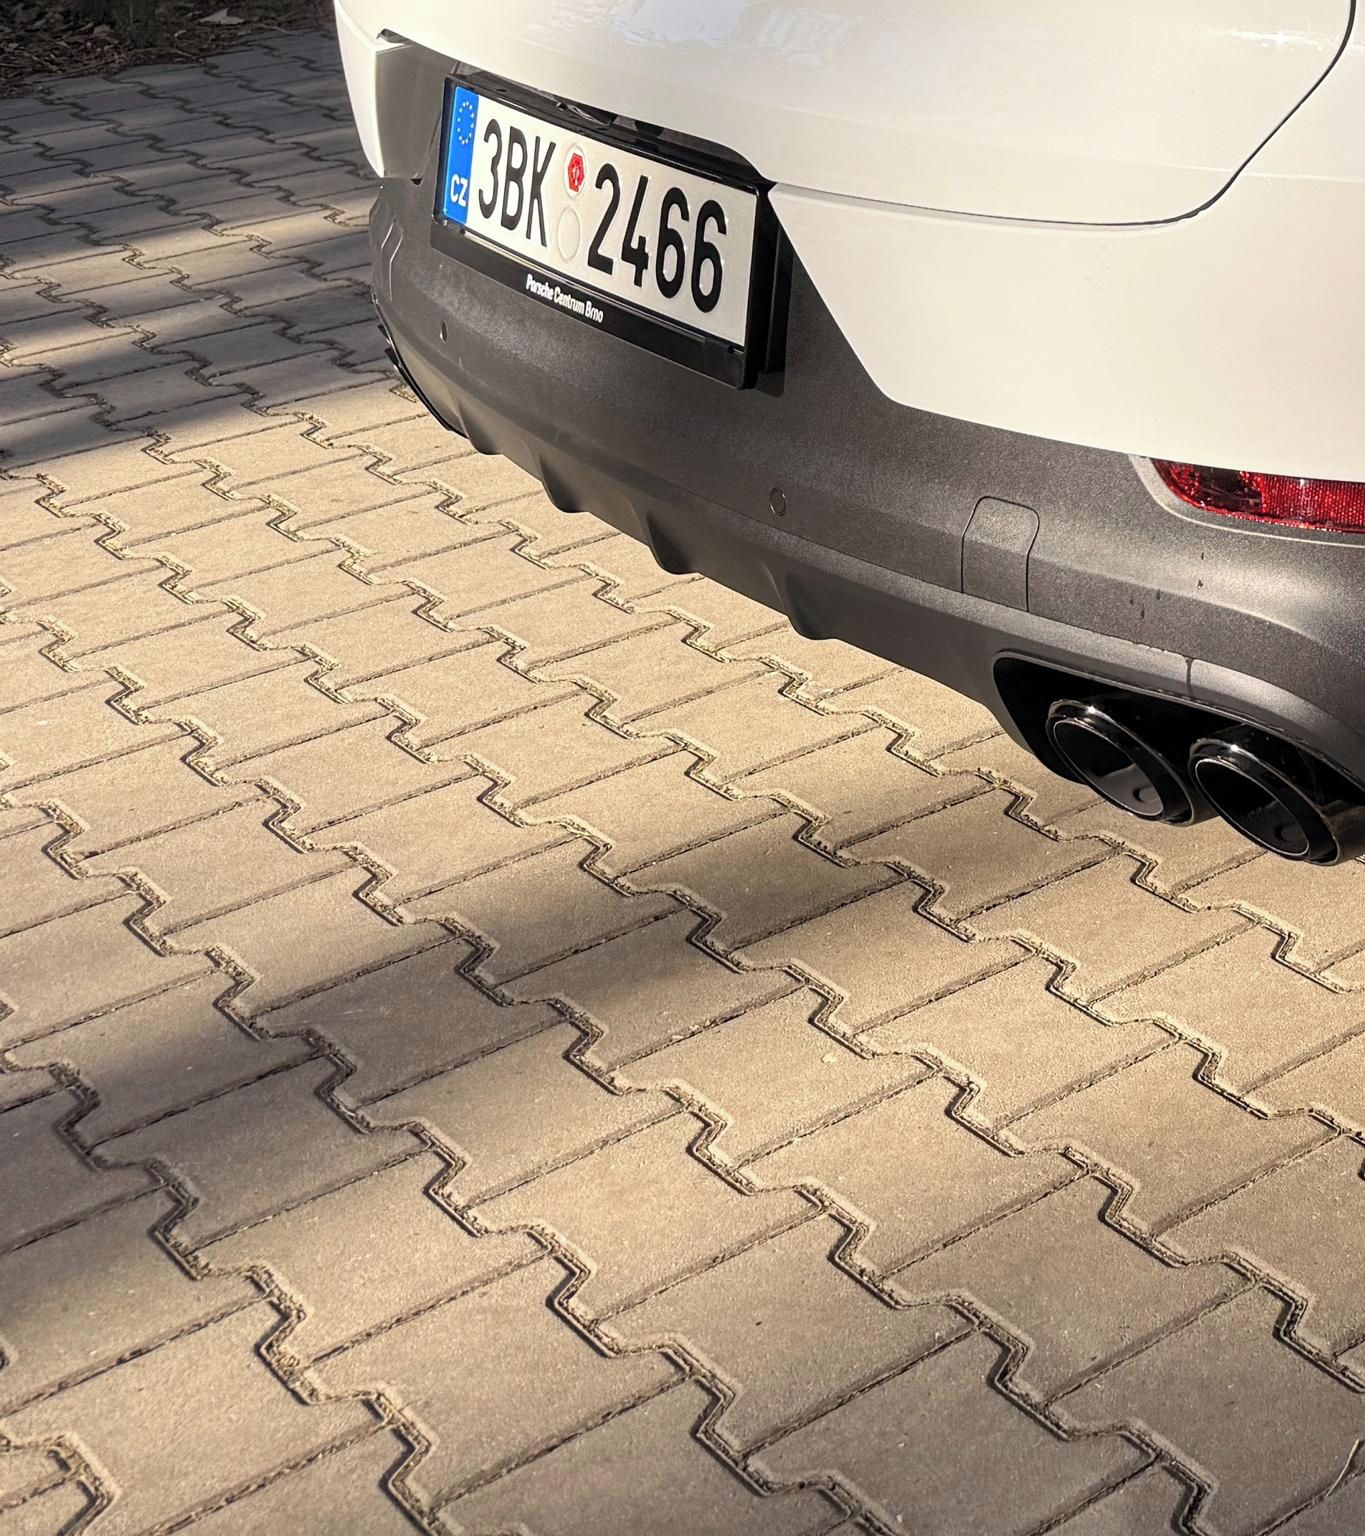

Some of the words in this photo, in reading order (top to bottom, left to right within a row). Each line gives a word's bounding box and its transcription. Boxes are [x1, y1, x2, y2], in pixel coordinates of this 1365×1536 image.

[450, 173, 469, 208] CZ
[477, 118, 557, 248] 3BK
[587, 162, 728, 314] 2466
[525, 273, 555, 301] Porsche
[553, 286, 586, 316] Centrum
[584, 300, 604, 323] Brno
